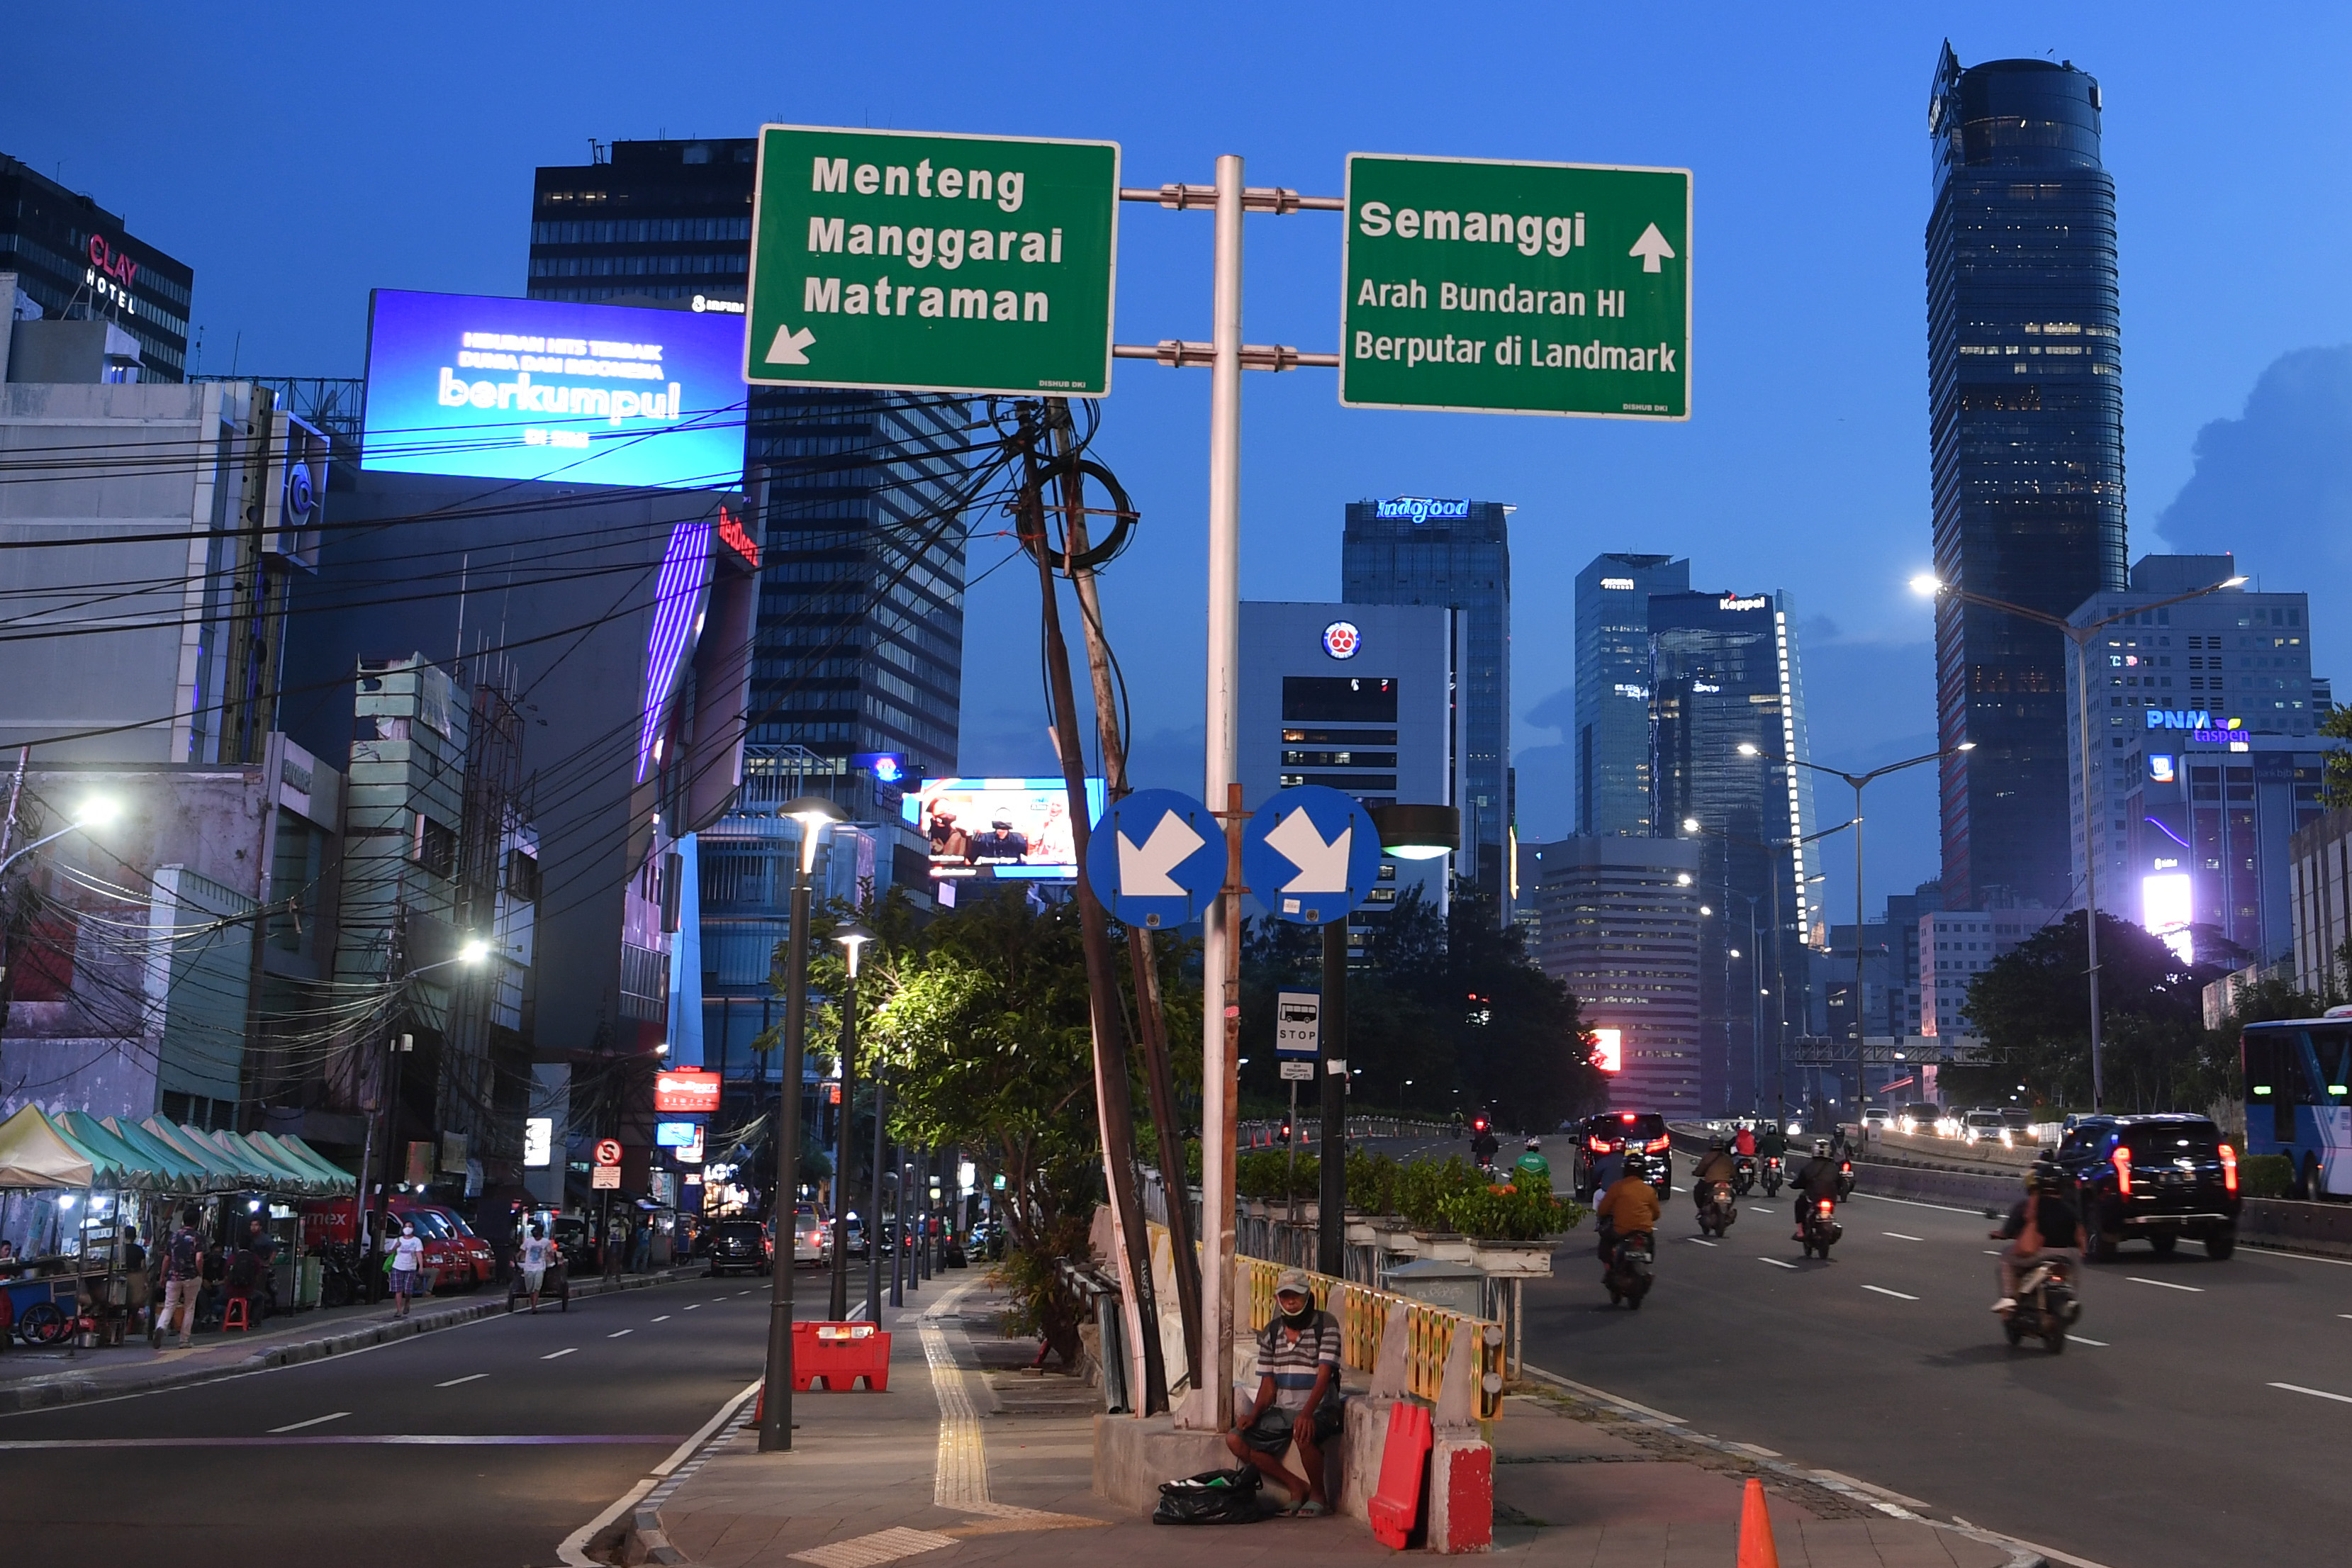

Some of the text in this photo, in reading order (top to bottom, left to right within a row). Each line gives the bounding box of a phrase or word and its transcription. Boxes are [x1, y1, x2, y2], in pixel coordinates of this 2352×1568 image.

[812, 157, 1024, 212] Menteng
[808, 217, 1062, 269] Manggarai
[1360, 202, 1585, 257] Semanggi
[91, 235, 138, 287] CLAY
[86, 269, 135, 315] HOTEL
[804, 276, 1048, 322] Matraman
[1357, 279, 1625, 317] Arah Bundaran HI
[547, 338, 587, 356] HITS
[1355, 330, 1676, 372] Berputar di Landmark
[439, 366, 681, 426] berkumpul
[1376, 498, 1469, 524] Indofood
[1720, 596, 1765, 611] Keppel
[2146, 710, 2212, 729] PNM
[2194, 729, 2250, 744] taspen
[1279, 1029, 1316, 1040] STOP
